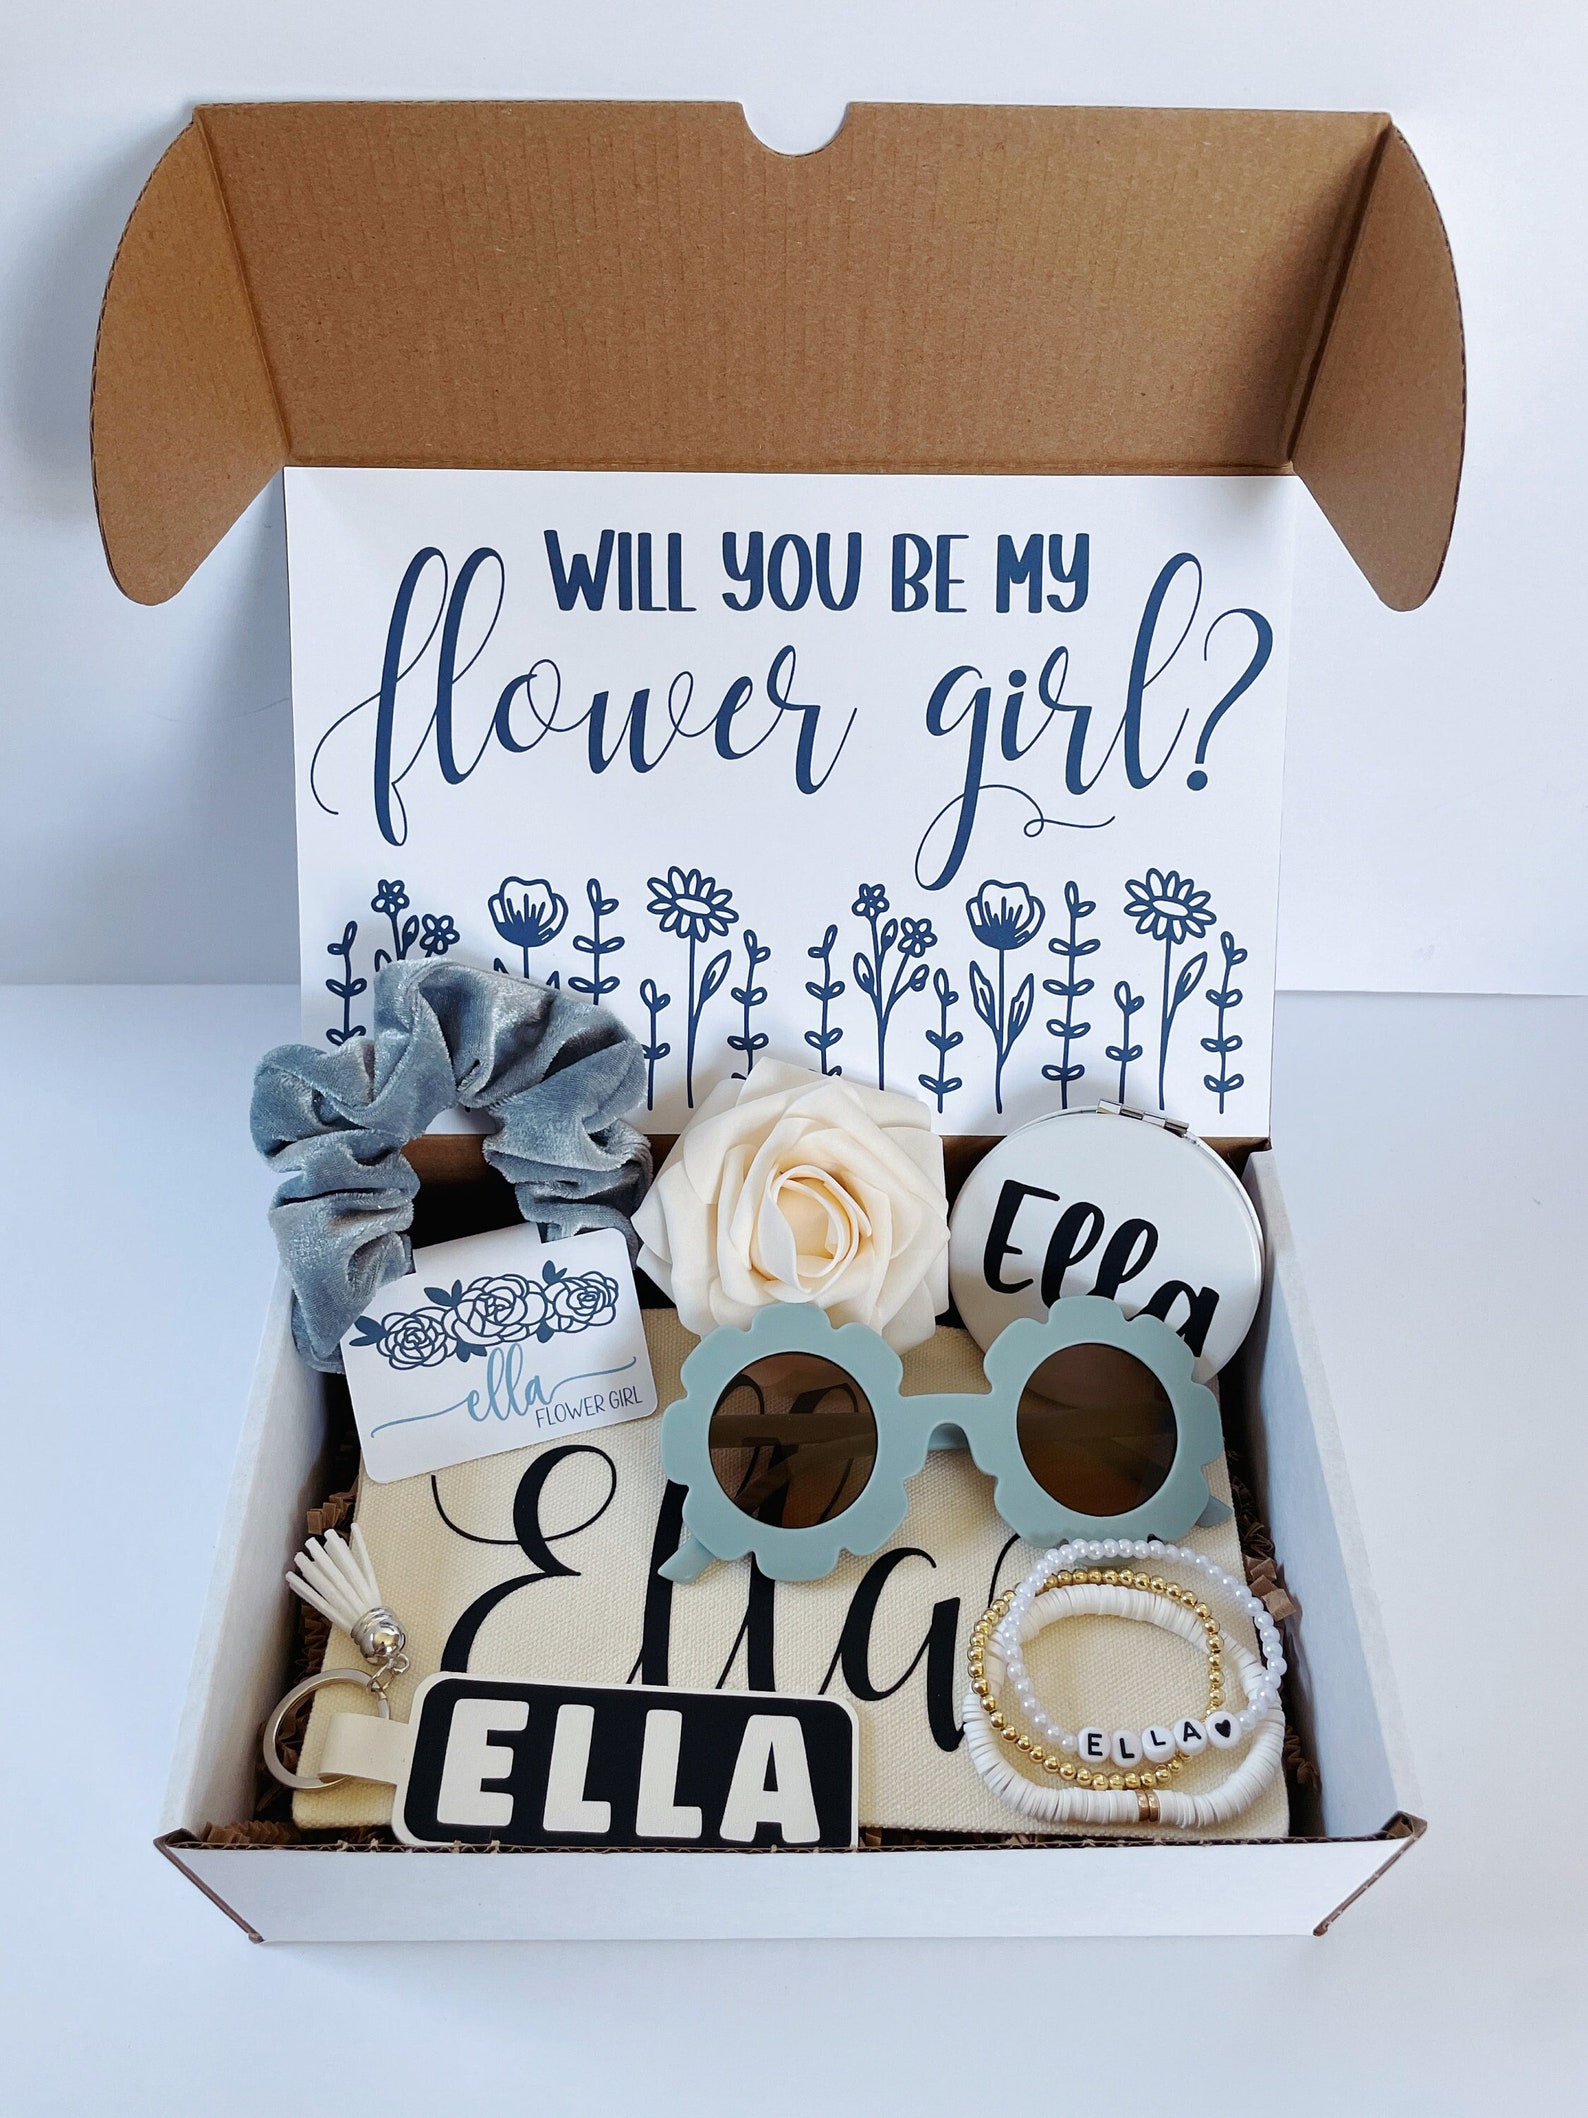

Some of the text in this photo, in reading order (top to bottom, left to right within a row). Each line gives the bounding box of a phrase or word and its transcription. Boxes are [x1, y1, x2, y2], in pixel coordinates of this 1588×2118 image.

[543, 529, 1090, 613] WILL YOU BE MY
[311, 547, 1275, 890] flower girl?
[983, 1179, 1220, 1358] Ella
[535, 1385, 644, 1429] FLOWER GIRL
[436, 1698, 821, 1844] ELLA
[1087, 1720, 1203, 1760] ELLA
